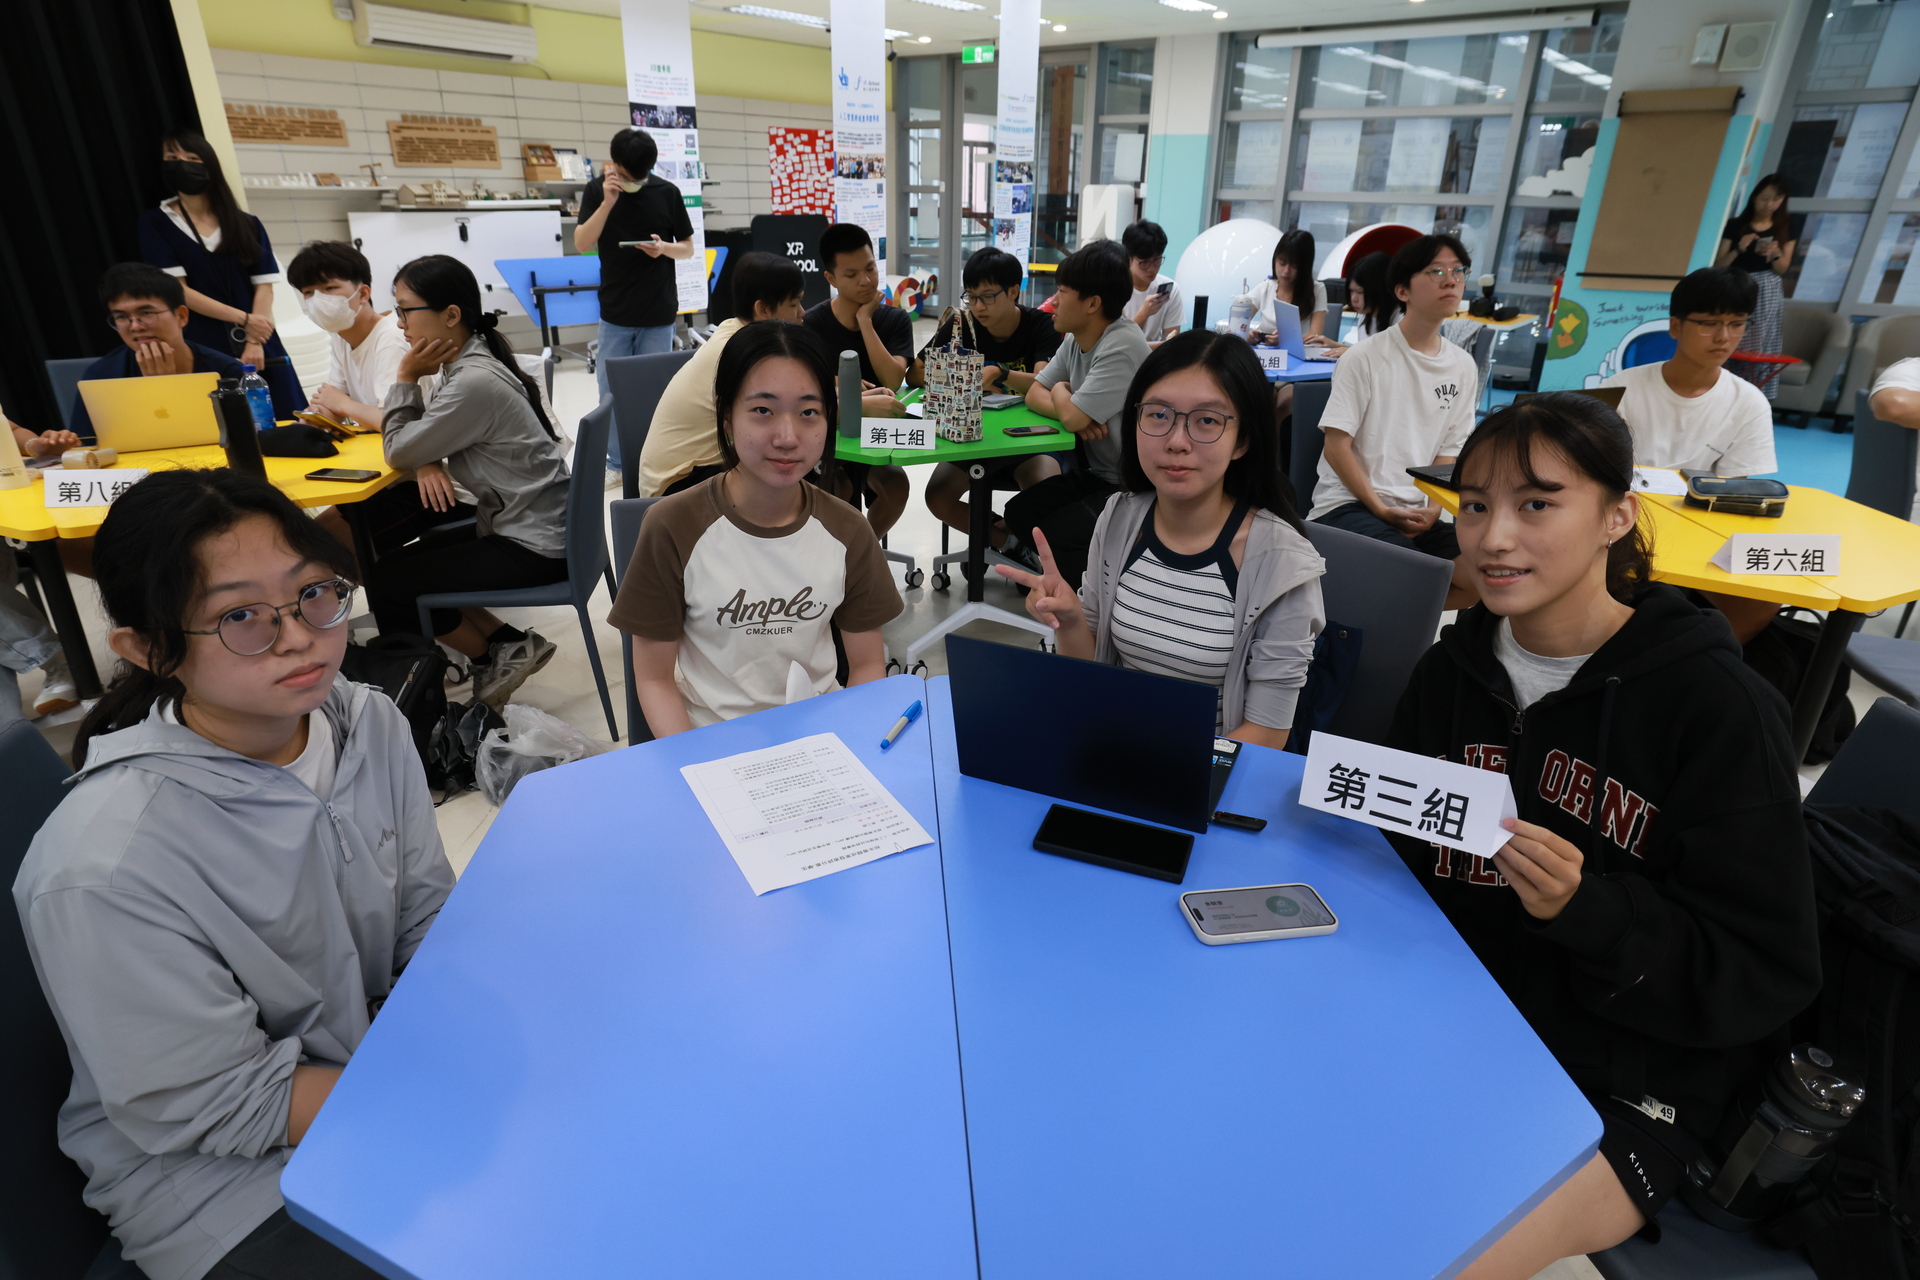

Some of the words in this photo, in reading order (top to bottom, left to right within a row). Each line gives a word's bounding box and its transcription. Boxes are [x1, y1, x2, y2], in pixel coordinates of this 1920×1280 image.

[786, 242, 804, 256] XR
[870, 427, 925, 446] 第七組
[1746, 547, 1825, 572] 第六組
[716, 586, 827, 628] Ample
[745, 626, 793, 635] CMZKUER
[1323, 762, 1470, 842] 第三組
[1660, 1106, 1673, 1119] 49
